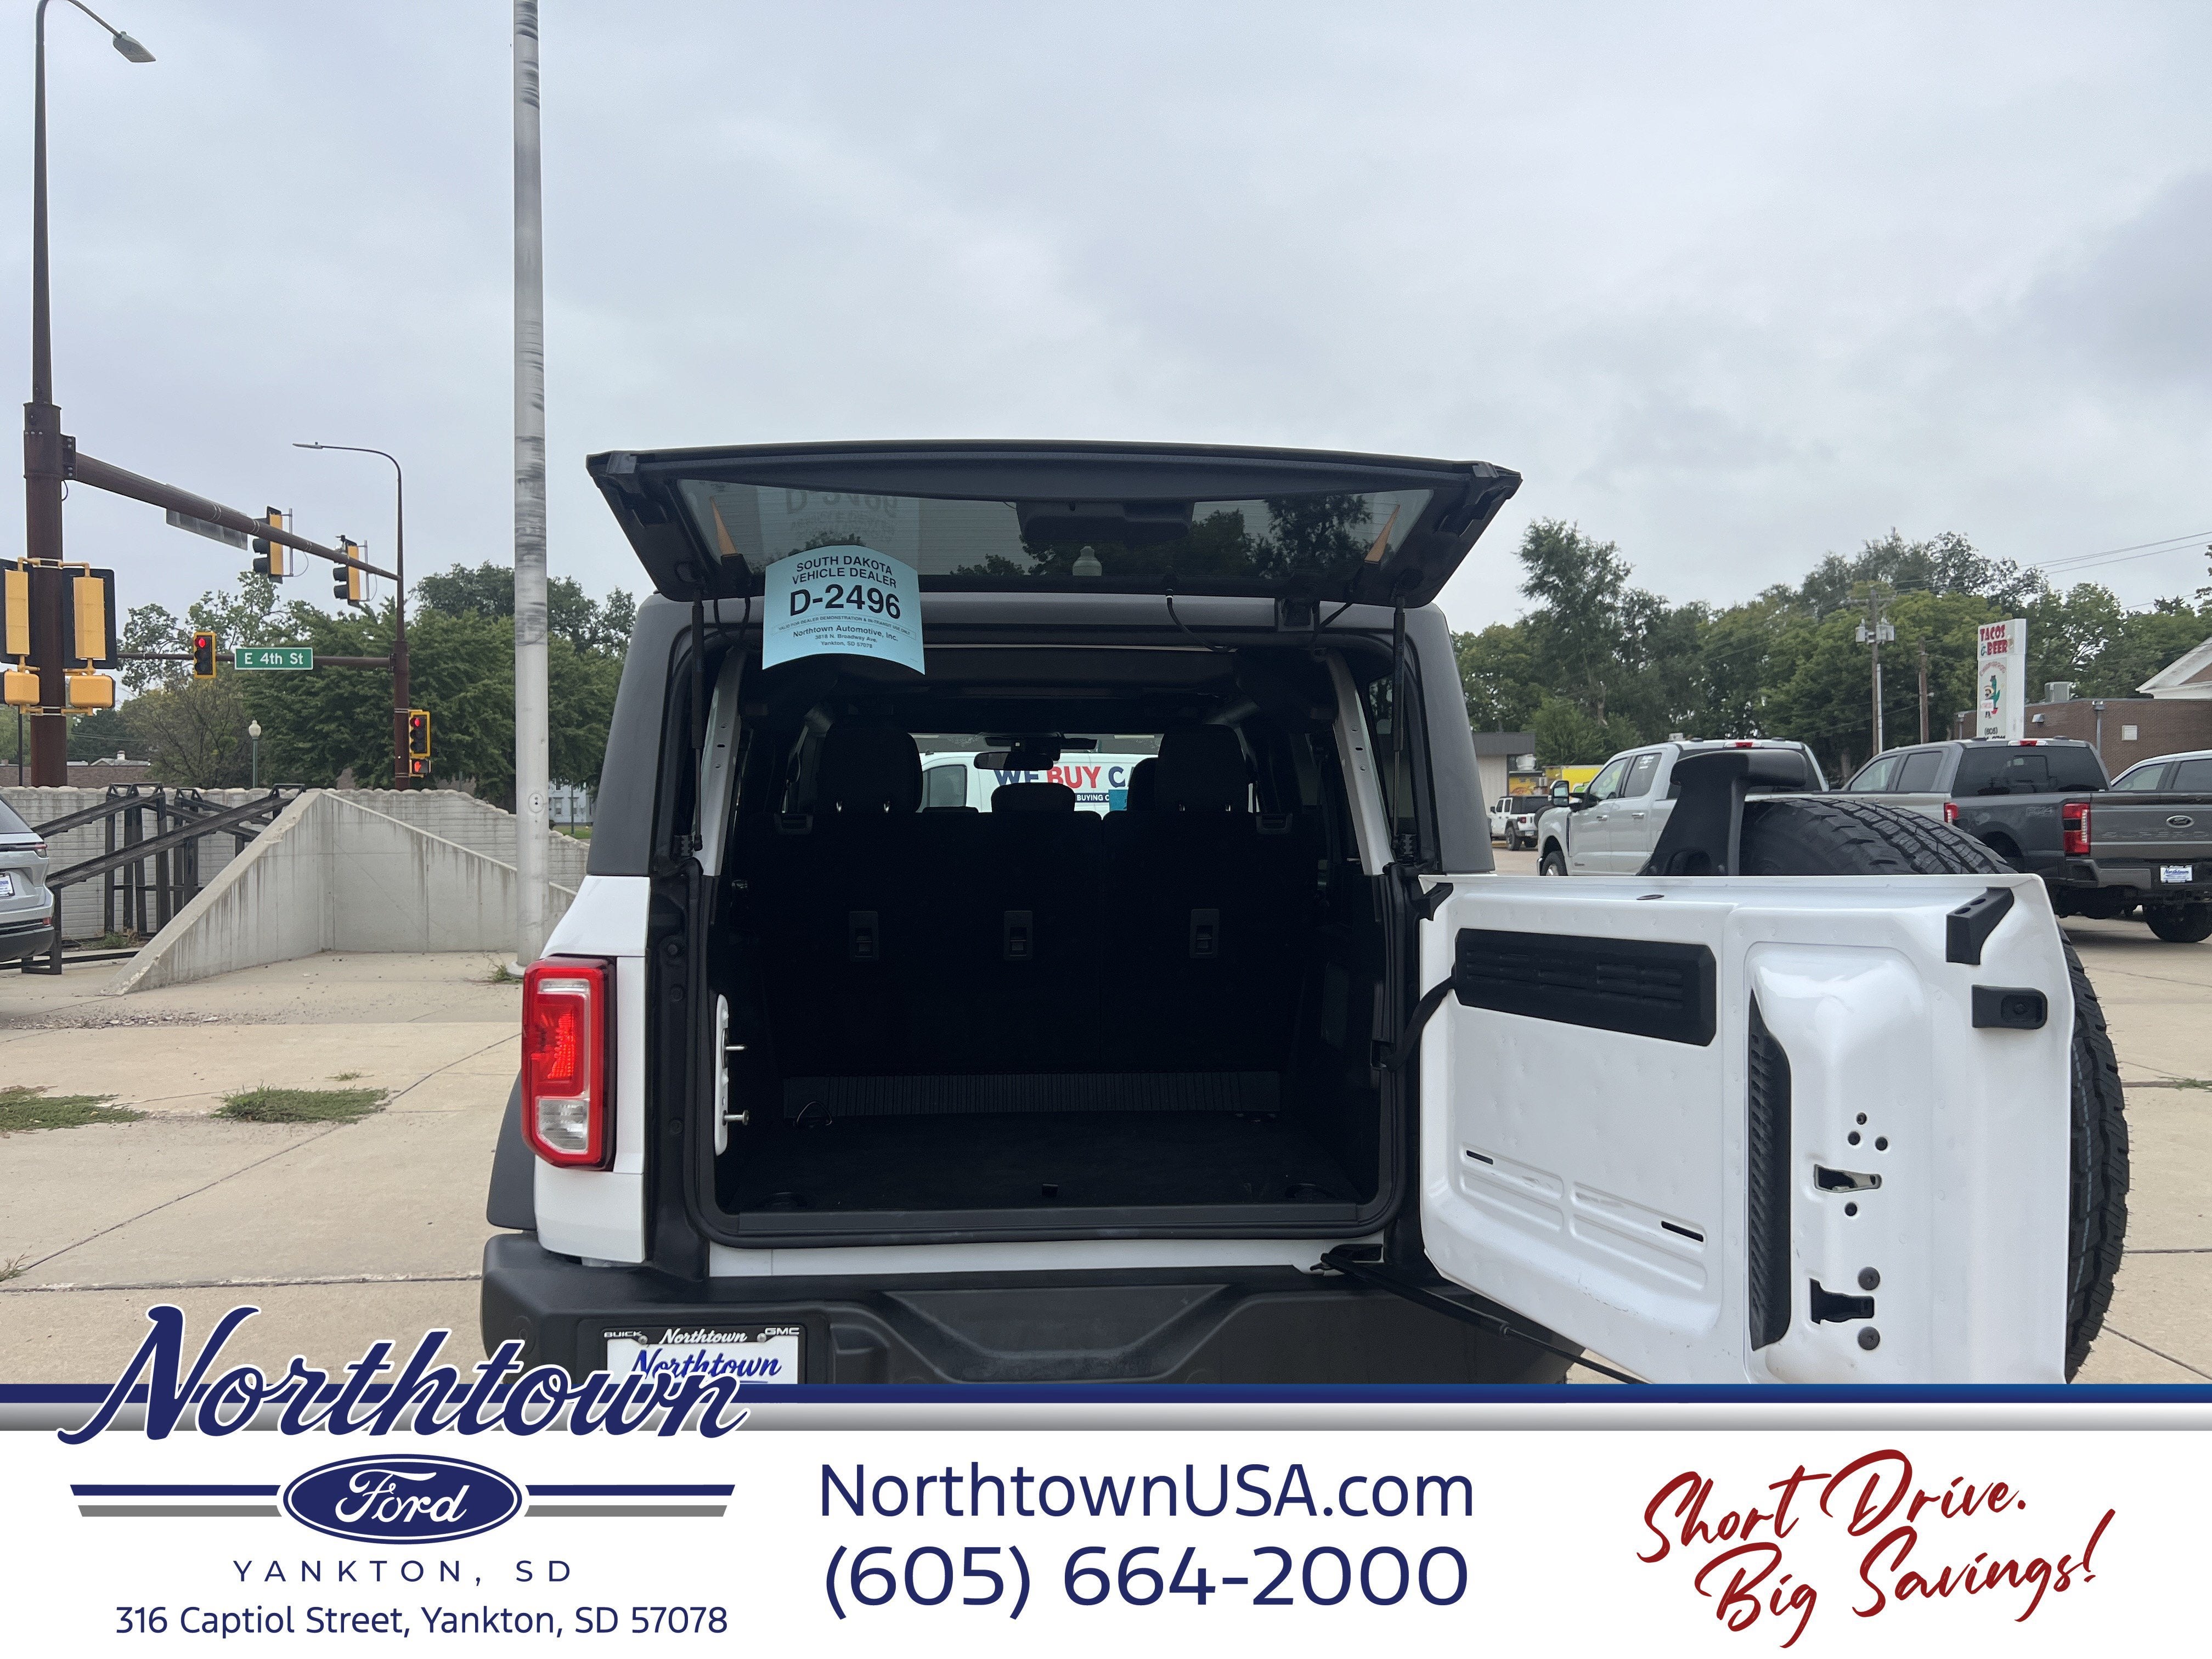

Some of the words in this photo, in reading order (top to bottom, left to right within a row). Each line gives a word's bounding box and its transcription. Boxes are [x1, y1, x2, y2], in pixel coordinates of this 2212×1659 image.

[797, 556, 838, 572] SOUTH
[844, 556, 893, 575] DAKOTA
[792, 568, 845, 585] VEHICLE
[850, 568, 896, 588] DEALER
[791, 584, 901, 619] D-2496
[793, 626, 833, 637] Northtown
[836, 625, 884, 638] Automotive,
[885, 632, 899, 641] Inc.
[1980, 624, 2006, 641] TACOS
[1987, 640, 2008, 655] BEER
[245, 652, 253, 664] E
[259, 652, 283, 664] 4th
[290, 652, 303, 664] St
[1047, 766, 1101, 788] BUY
[658, 1328, 747, 1344] Northtown
[765, 1327, 799, 1335] GMC
[631, 1348, 781, 1380] Northtown
